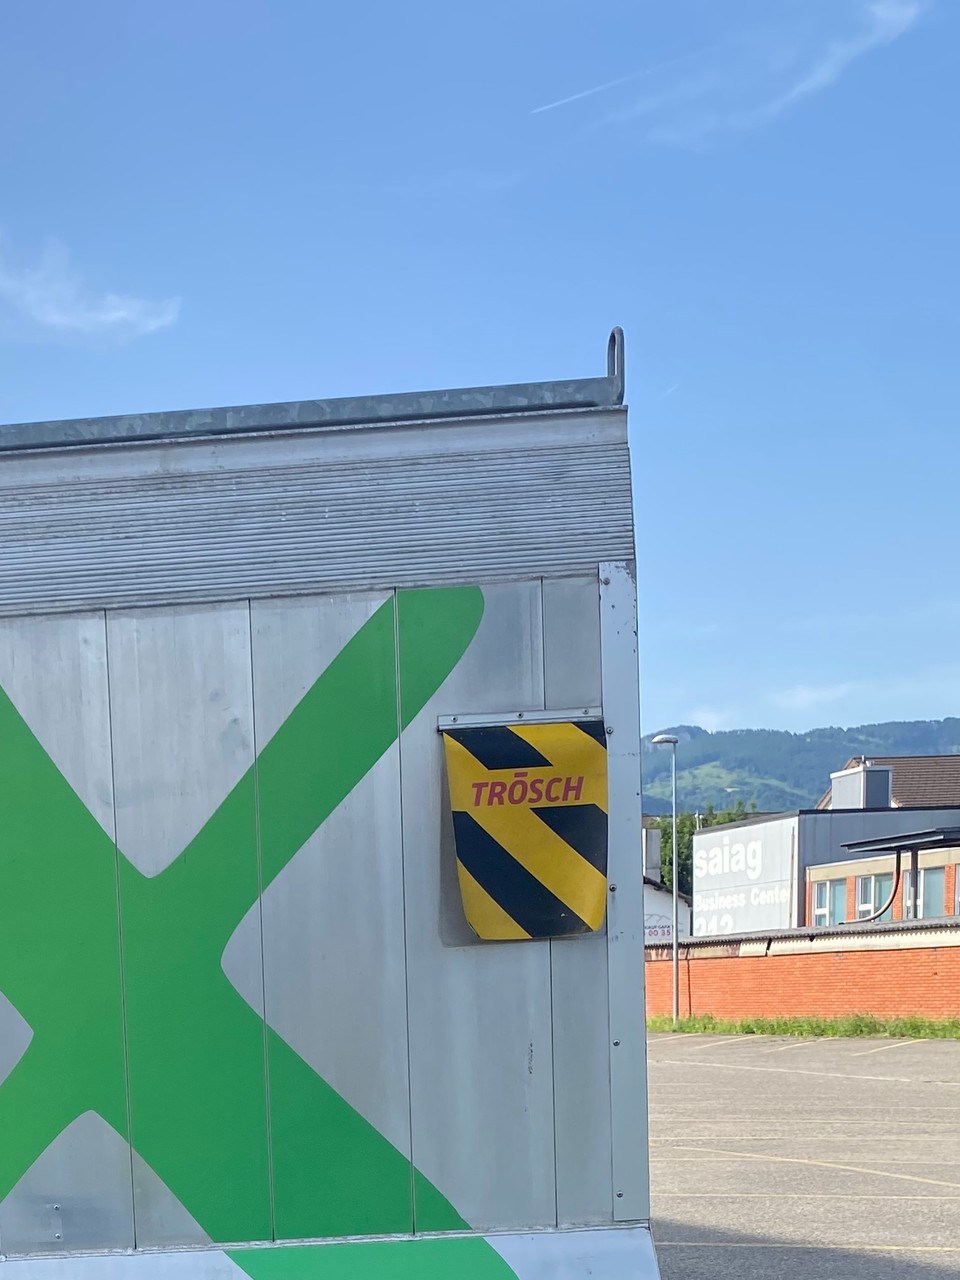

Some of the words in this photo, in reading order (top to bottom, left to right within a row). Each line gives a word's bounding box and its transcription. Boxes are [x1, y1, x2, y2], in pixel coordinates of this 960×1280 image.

[695, 835, 762, 880] saiag
[695, 893, 746, 912] Business
[750, 886, 790, 906] Cente
